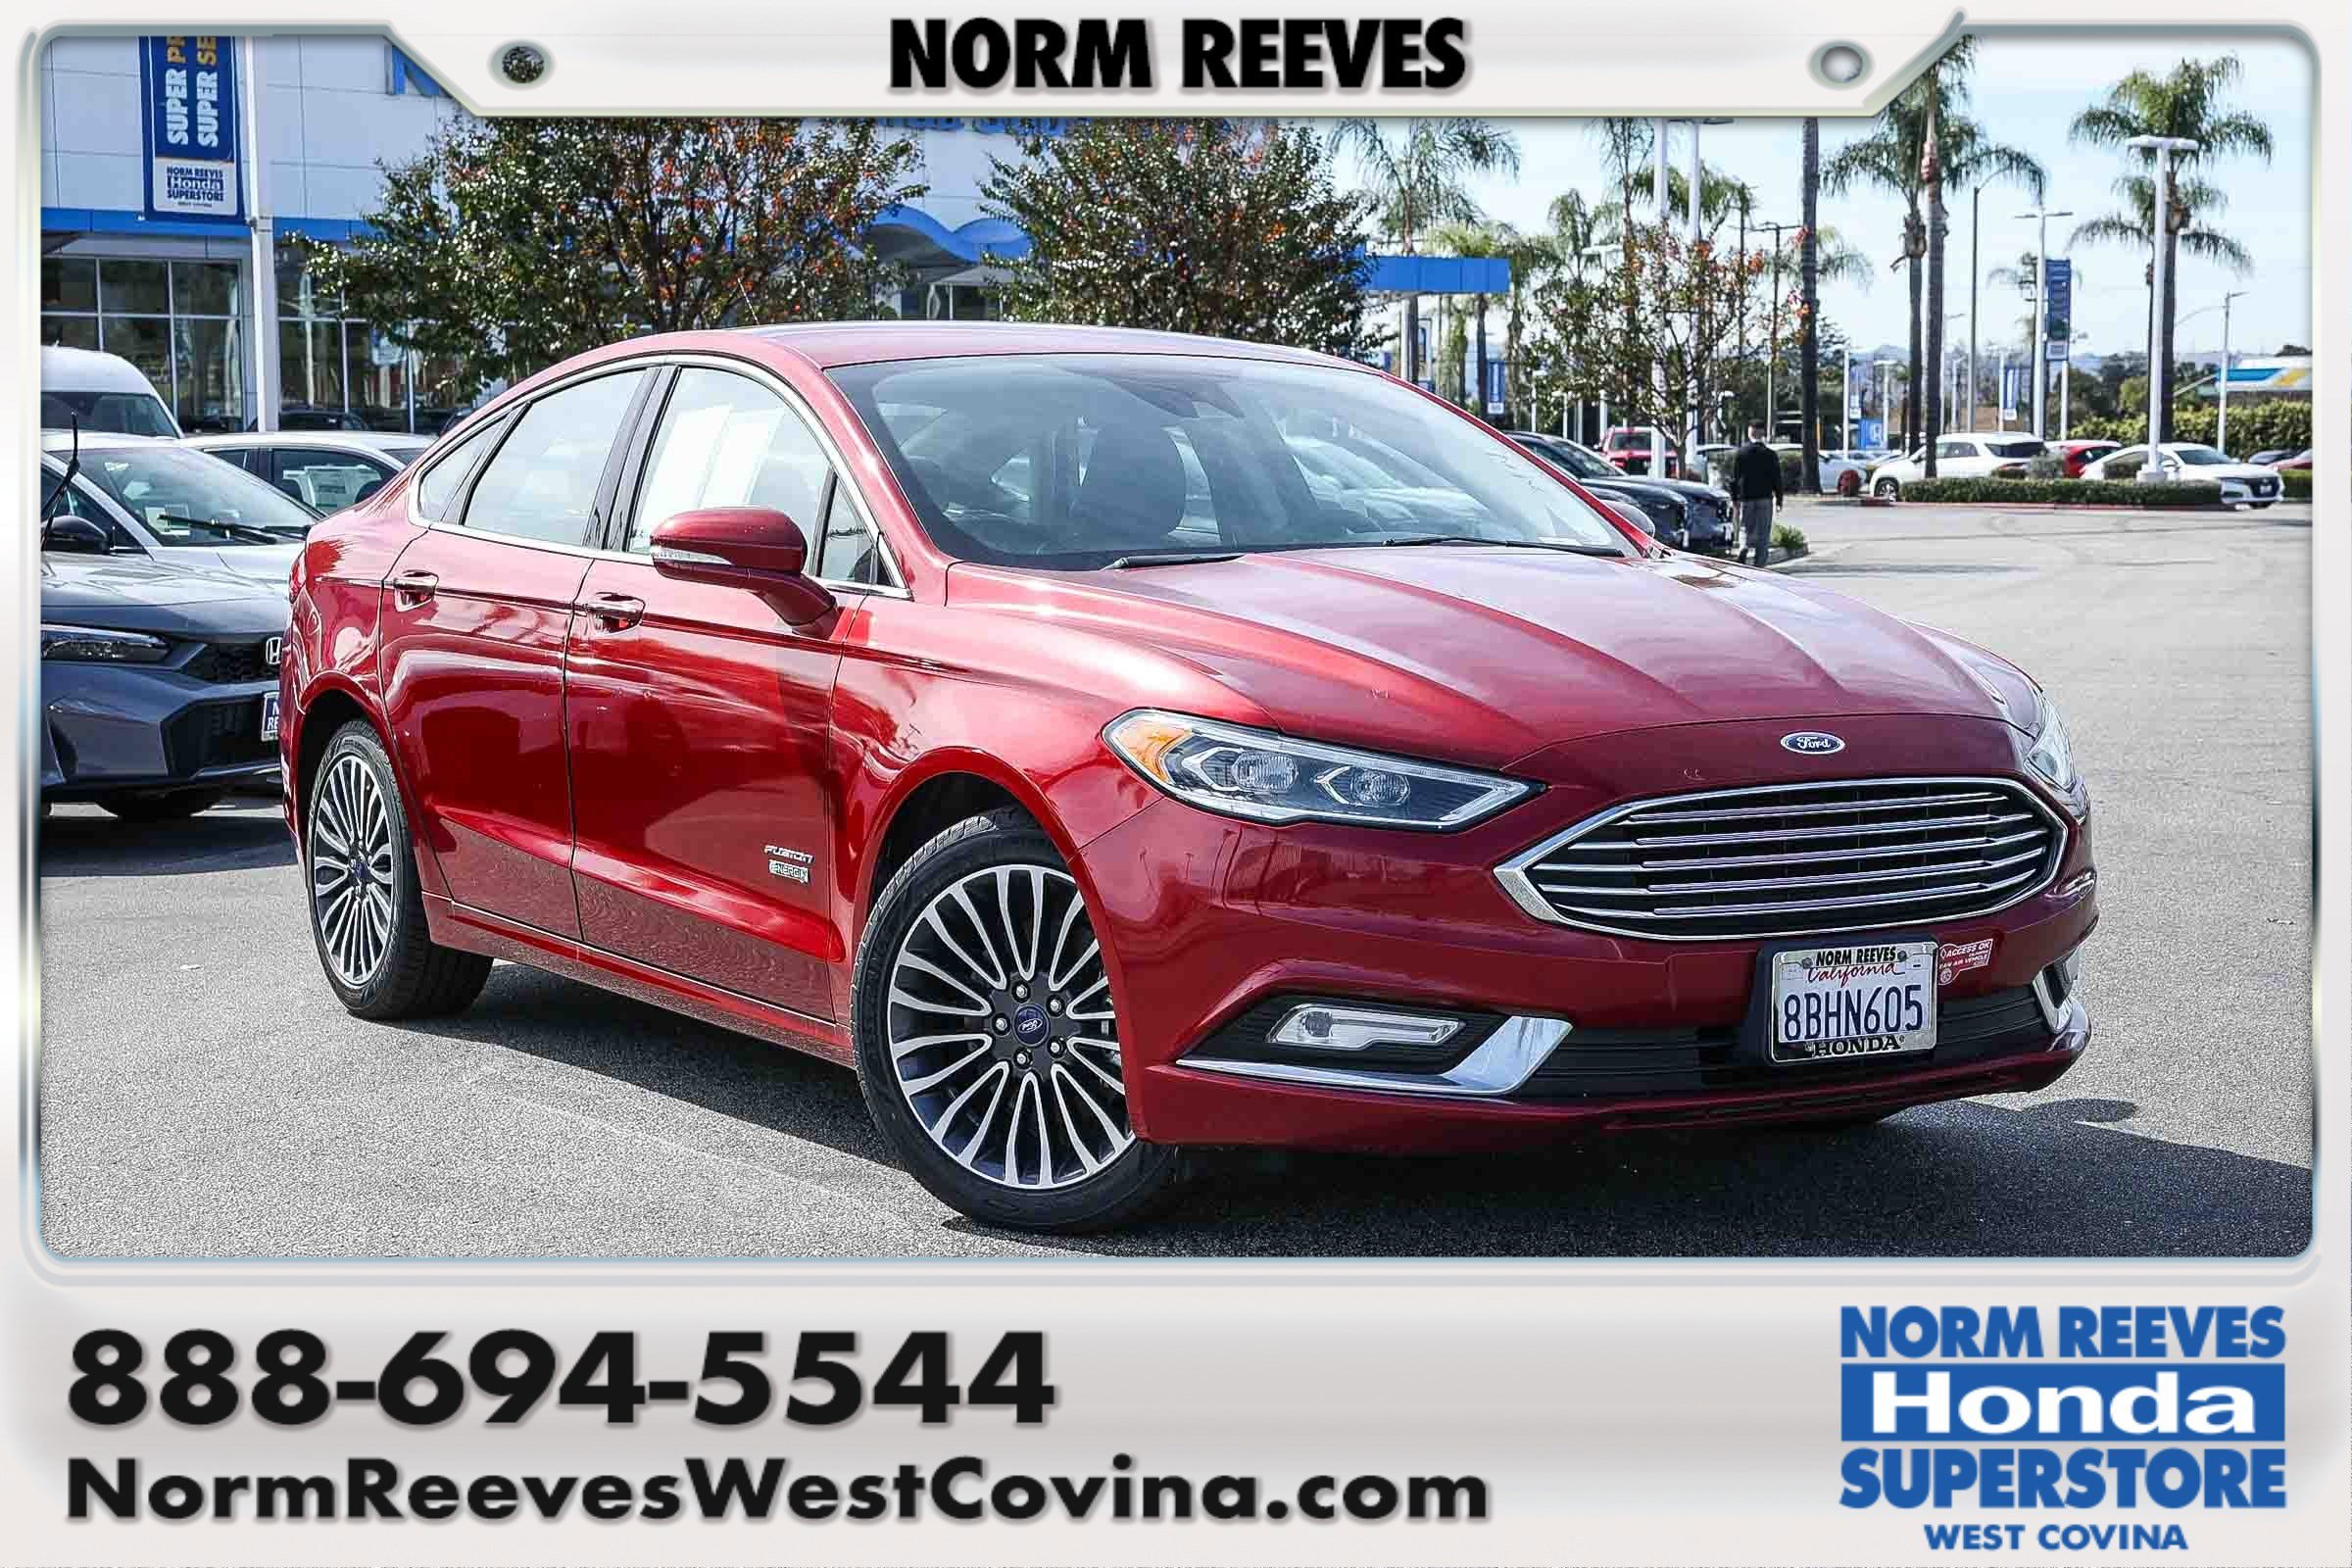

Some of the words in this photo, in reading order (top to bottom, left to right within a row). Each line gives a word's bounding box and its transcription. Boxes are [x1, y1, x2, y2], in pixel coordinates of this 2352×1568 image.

[166, 69, 188, 145] SUPER
[197, 71, 218, 147] SUPER
[171, 177, 221, 190] Honda
[167, 189, 223, 202] SUPERSTORE
[1796, 736, 1832, 749] Ford
[764, 845, 813, 863] FUSION
[1816, 951, 1852, 966] NORM
[1856, 947, 1897, 963] REEVES
[1946, 945, 1977, 957] ACCESS
[1979, 941, 1989, 951] OK
[1807, 962, 1905, 988] California
[1784, 984, 1924, 1041] 8BHN605
[1813, 1034, 1901, 1057] HONDA
